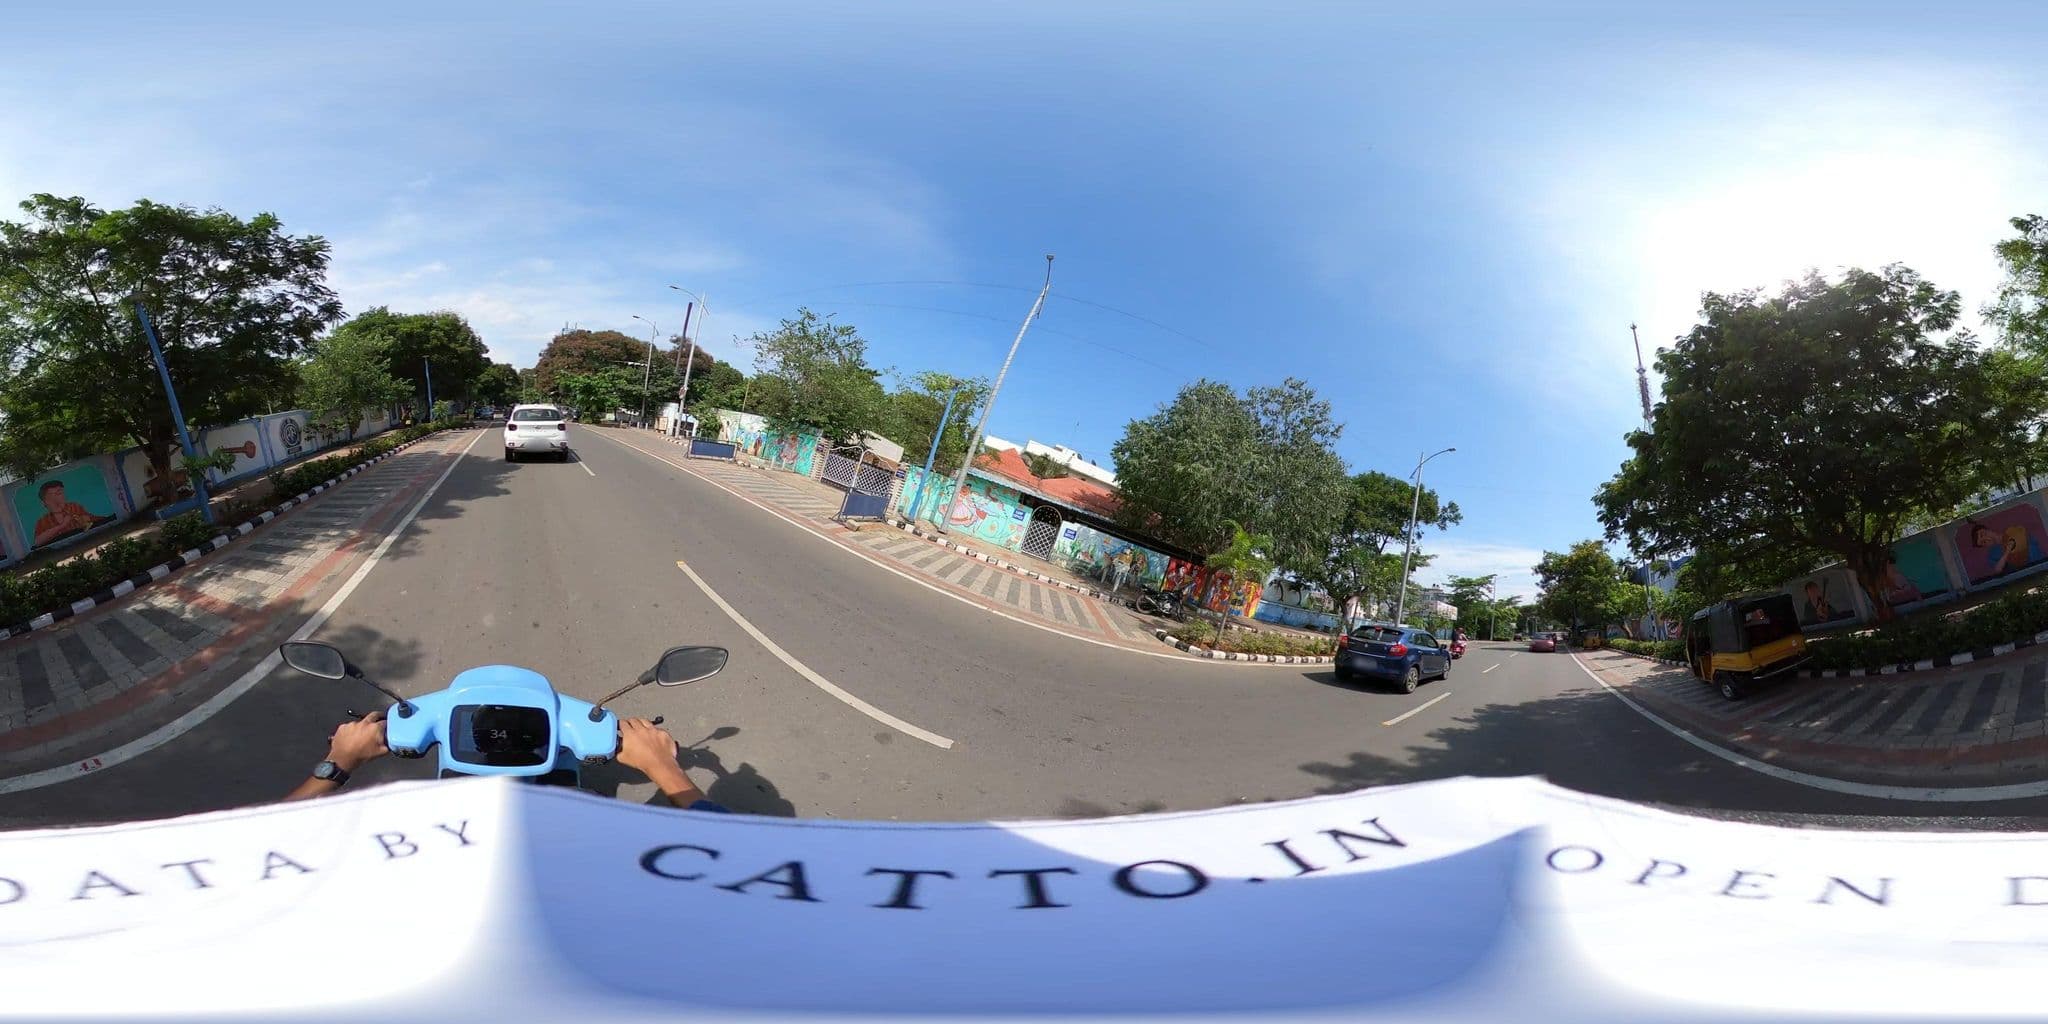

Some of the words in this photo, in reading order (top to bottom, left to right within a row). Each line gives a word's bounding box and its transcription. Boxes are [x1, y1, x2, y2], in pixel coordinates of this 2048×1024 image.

[490, 729, 507, 739] 34
[372, 819, 477, 860] BY
[638, 816, 1409, 911] CATTO.IN
[1545, 845, 1893, 907] OPEN
